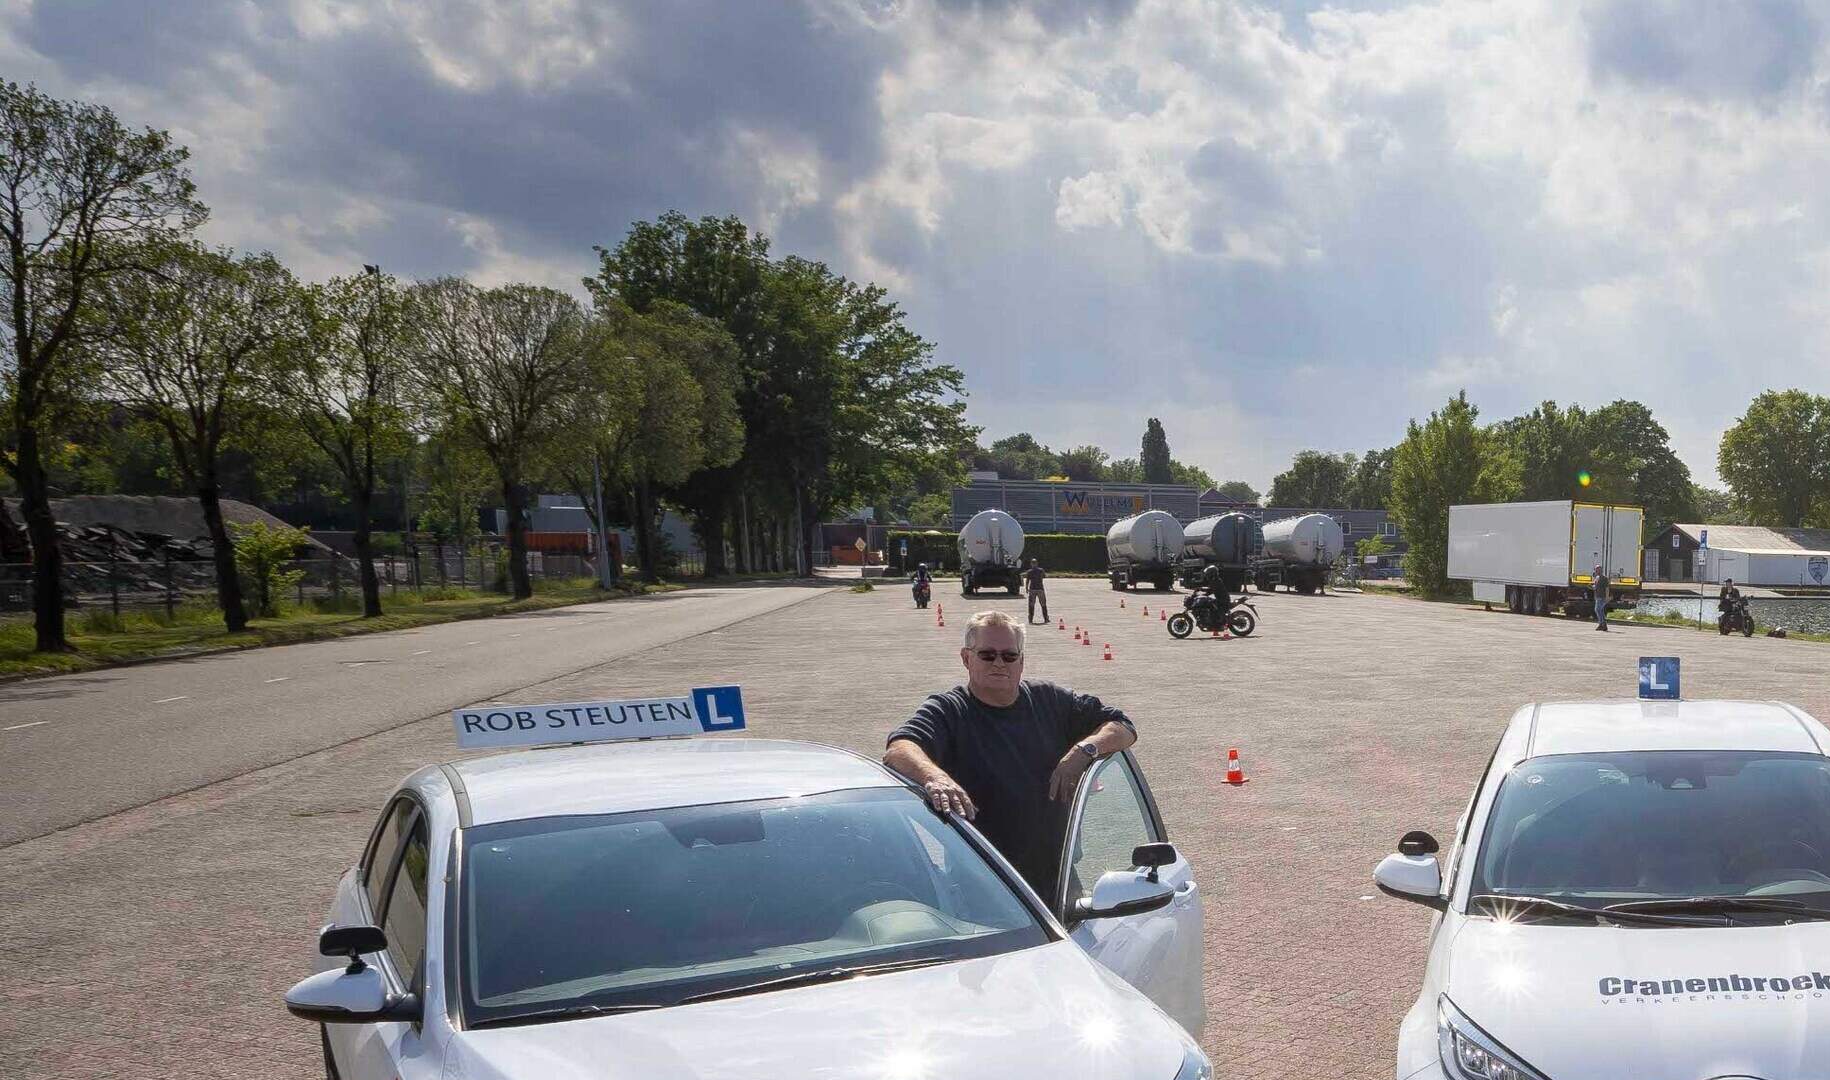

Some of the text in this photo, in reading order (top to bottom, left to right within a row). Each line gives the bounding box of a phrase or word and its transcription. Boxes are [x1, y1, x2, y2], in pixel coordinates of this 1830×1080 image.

[1650, 663, 1669, 690] L
[462, 701, 692, 733] ROB STEUTEN
[706, 694, 734, 725] L
